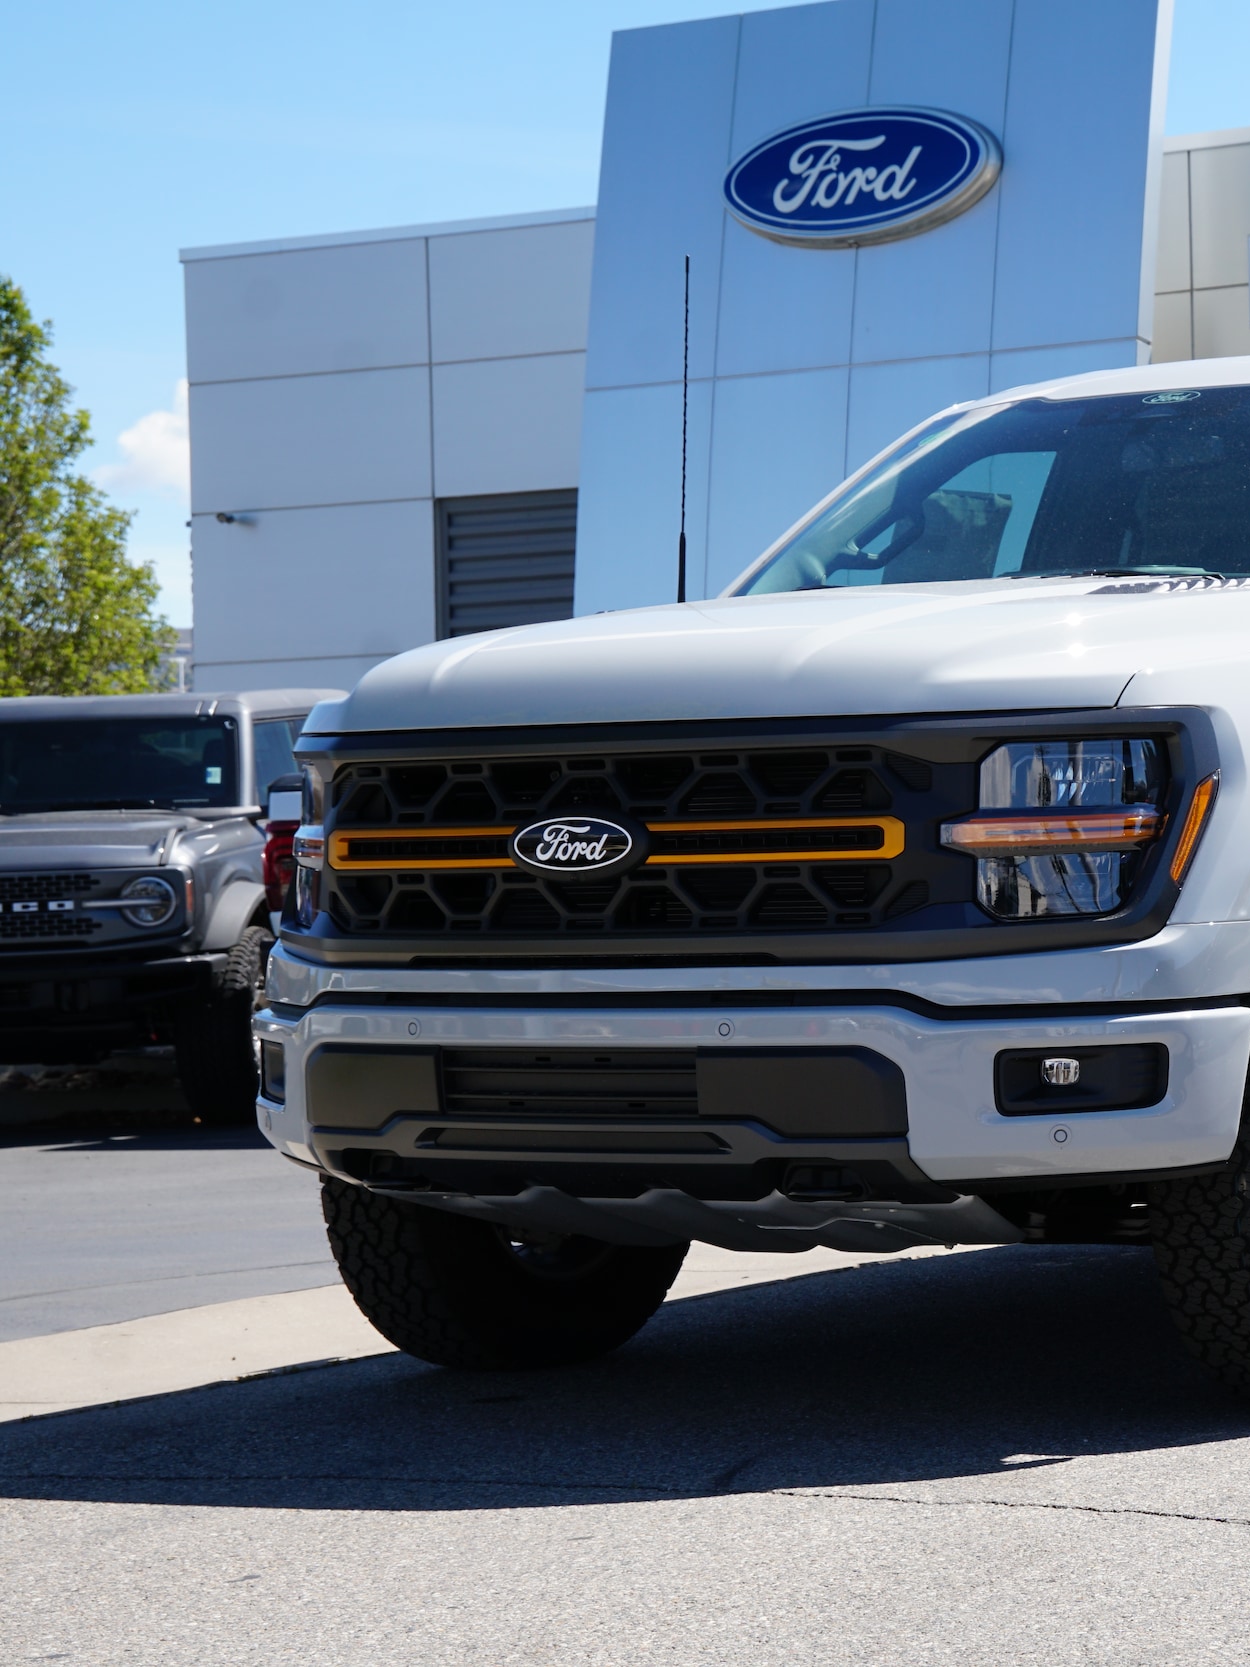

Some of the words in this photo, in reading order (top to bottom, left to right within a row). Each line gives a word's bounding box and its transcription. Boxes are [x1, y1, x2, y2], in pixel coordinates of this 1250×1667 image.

[772, 134, 923, 214] Ford
[535, 824, 609, 861] Ford
[0, 900, 75, 913] CO
